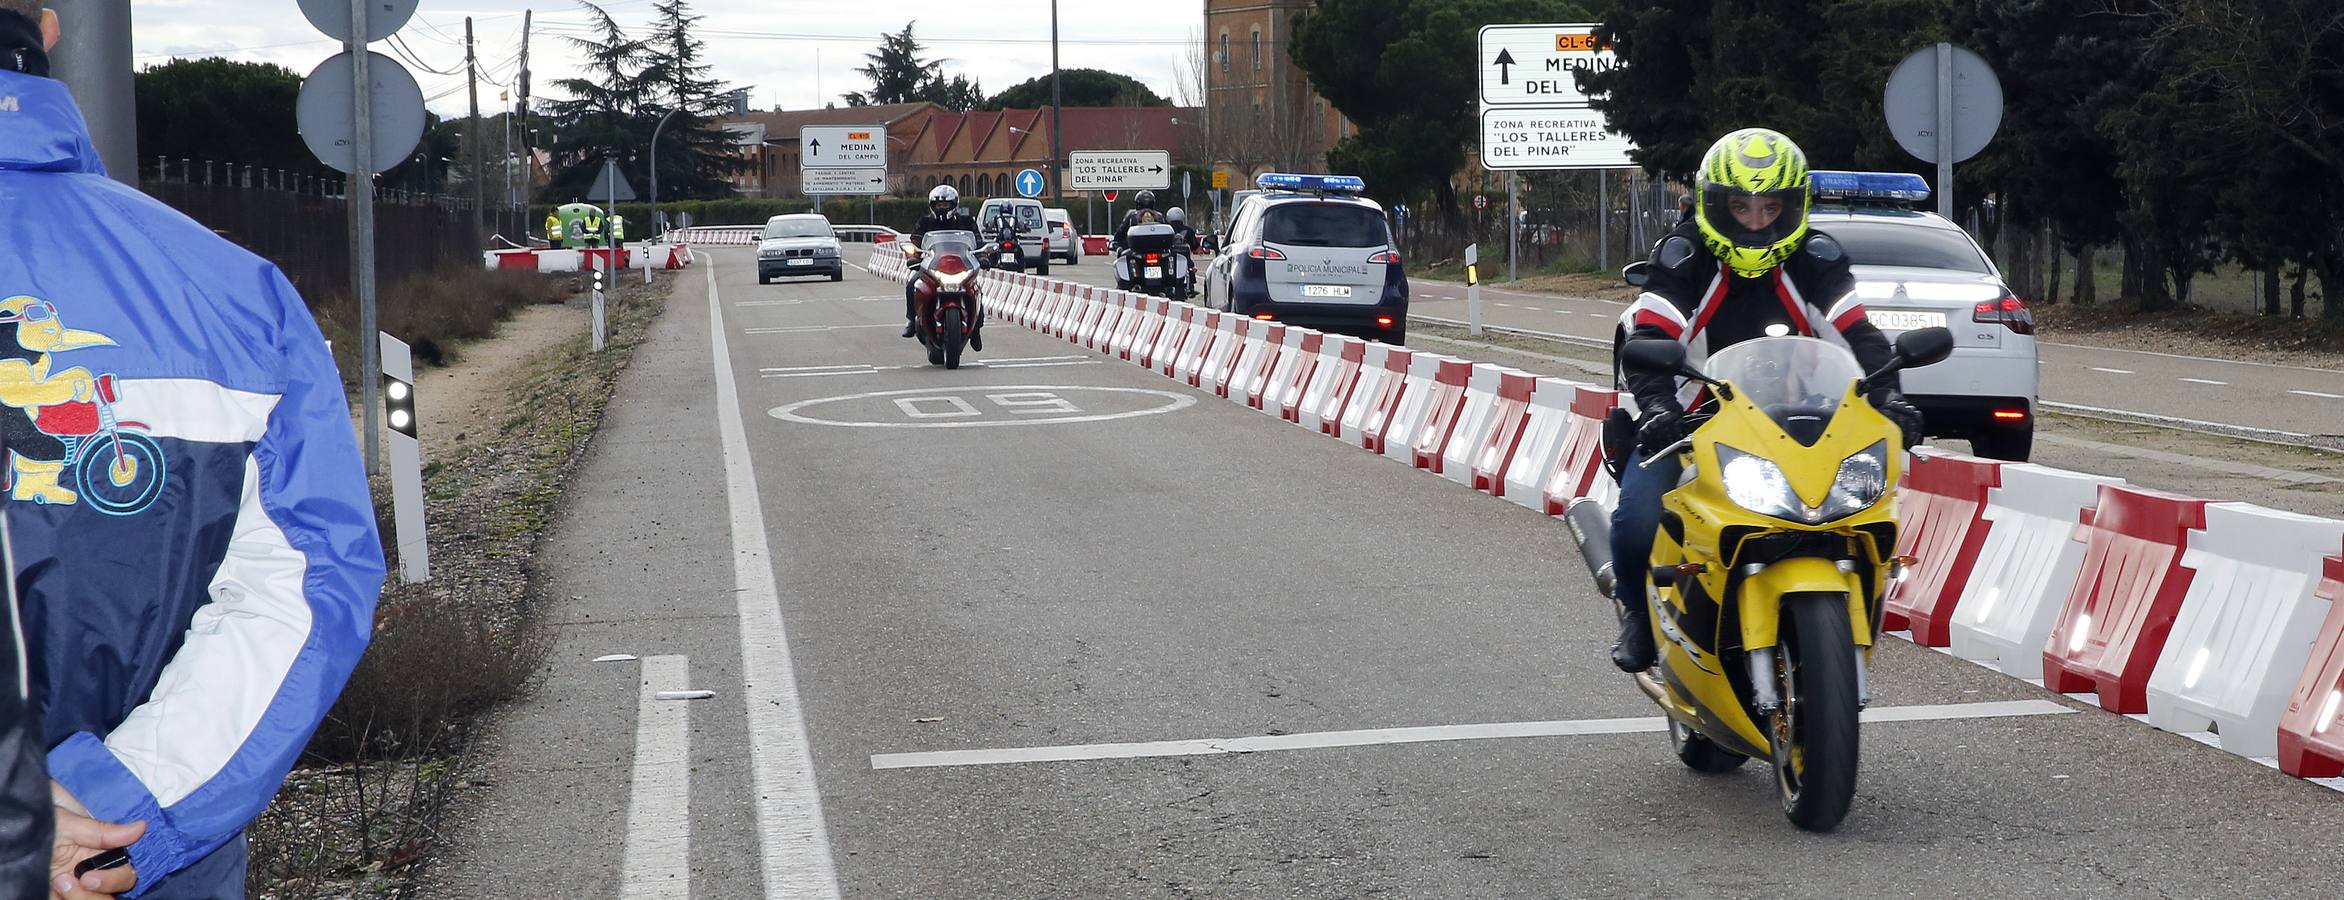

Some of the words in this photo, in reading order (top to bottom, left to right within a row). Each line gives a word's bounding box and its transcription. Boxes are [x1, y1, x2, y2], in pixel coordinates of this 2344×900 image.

[1526, 80, 1562, 94] DEL
[1494, 120, 1524, 129] ZONA
[1530, 120, 1597, 128] RECREATIVA
[1494, 132, 1528, 142] "LOS
[1537, 131, 1606, 142] TALLERES
[1494, 147, 1519, 157] DEL
[1528, 145, 1576, 156] PINAR"
[1323, 265, 1361, 274] MUNICIPAL
[1308, 287, 1328, 295] 1276
[1891, 313, 1928, 328] 0385
[893, 392, 1085, 418] 50
